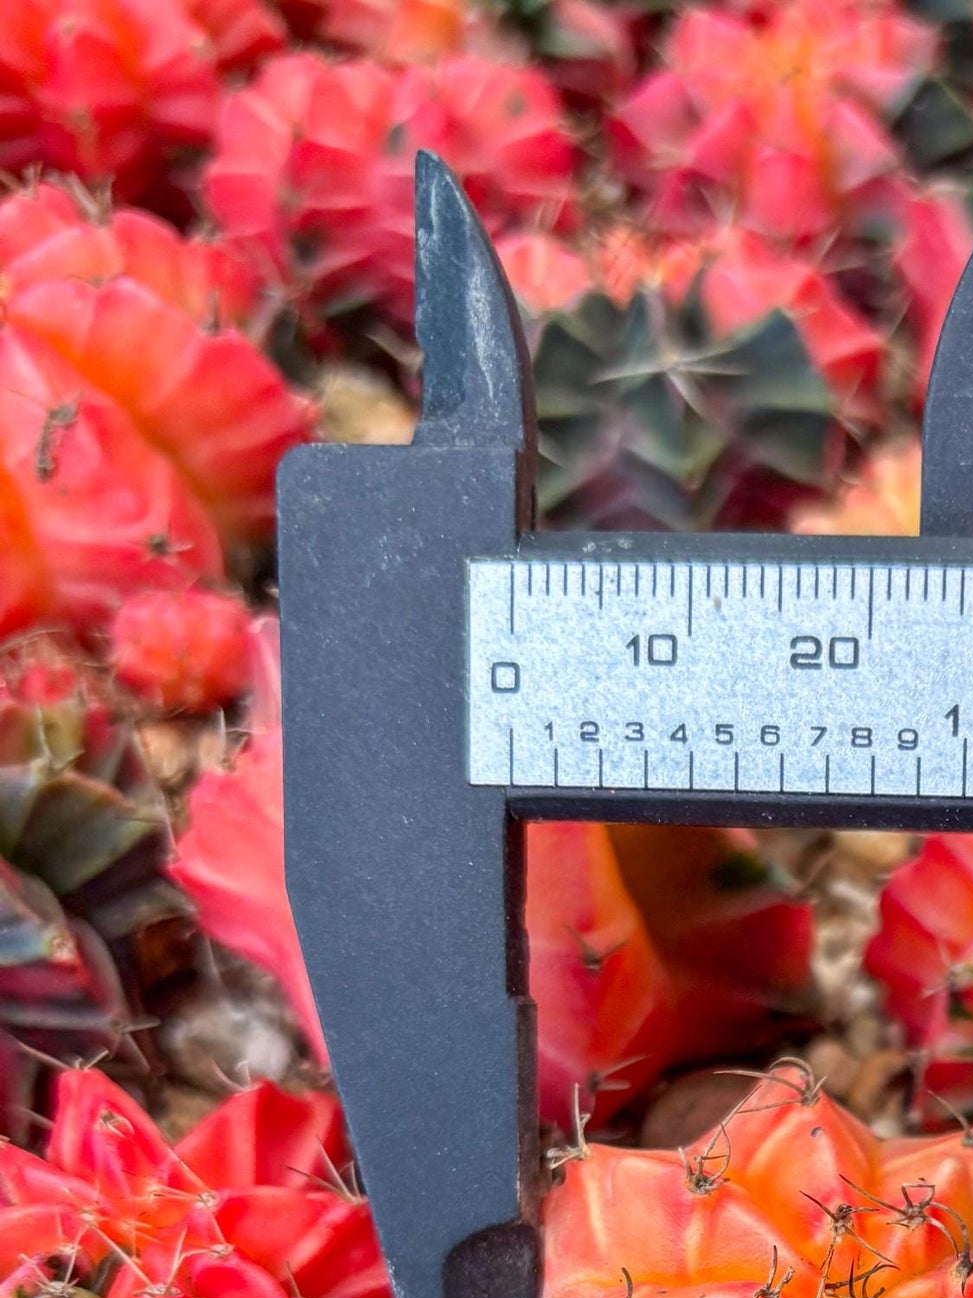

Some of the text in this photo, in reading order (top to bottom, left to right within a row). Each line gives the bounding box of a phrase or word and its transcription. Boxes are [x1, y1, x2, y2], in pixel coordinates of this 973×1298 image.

[490, 661, 521, 694] 0
[625, 633, 678, 667] 10
[789, 635, 860, 670] 20
[544, 721, 554, 741] 1
[579, 721, 601, 742] 2
[624, 722, 645, 742] 3
[669, 723, 689, 744] 4
[714, 724, 735, 745] 5
[760, 725, 781, 746] 6
[810, 727, 828, 747] 7
[851, 727, 873, 748] 8
[897, 729, 919, 750] 9
[944, 704, 960, 737] 1
